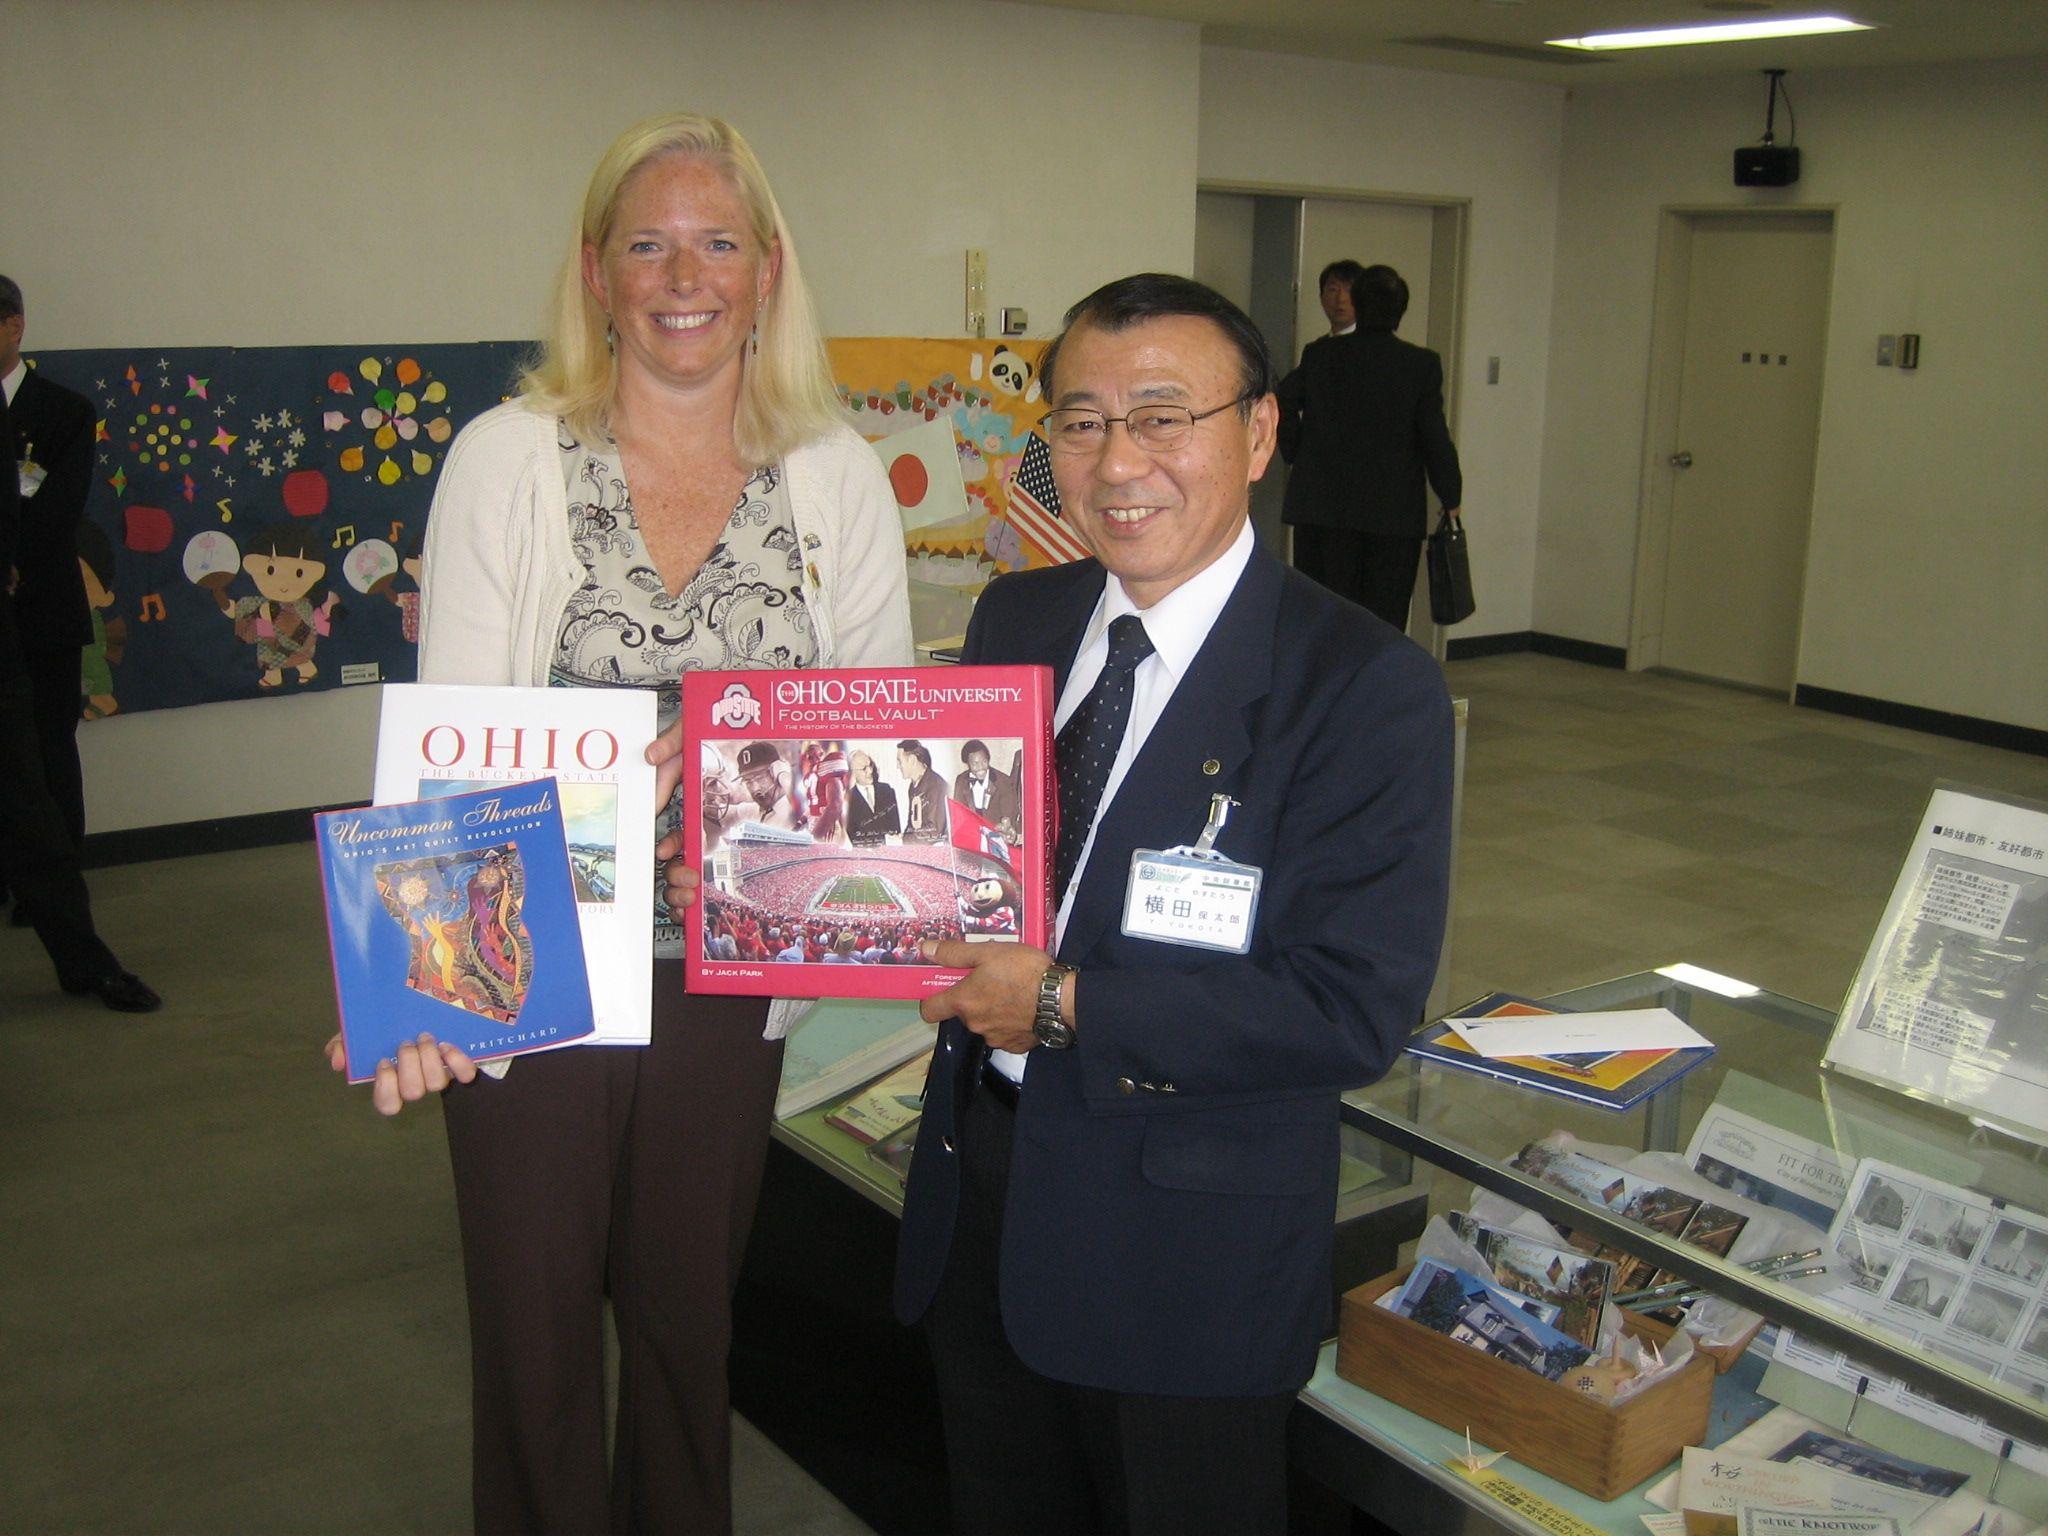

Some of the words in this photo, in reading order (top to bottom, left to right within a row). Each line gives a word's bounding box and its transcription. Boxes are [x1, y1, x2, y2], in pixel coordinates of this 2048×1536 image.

[776, 679, 846, 705] OHIO
[849, 679, 917, 705] STATE
[920, 687, 1021, 703] UNIVERSITY
[778, 709, 874, 722] FOOTBALL
[878, 708, 940, 721] VAULT
[422, 725, 619, 771] OHIO
[419, 768, 456, 778] THE
[467, 769, 553, 780] BUCKEYE
[562, 772, 619, 782] STATE
[328, 817, 456, 845] Uncommon
[463, 791, 553, 827] Threads
[343, 846, 387, 858] OHIO'S
[395, 843, 417, 852] ART
[424, 836, 460, 848] QUILT
[467, 820, 542, 841] REVOLUTION
[716, 969, 739, 977] JACK
[739, 969, 764, 977] PARK
[469, 1027, 558, 1051] PRITCHARD
[1778, 1153, 1799, 1169] FIT
[1800, 1162, 1824, 1178] FOR
